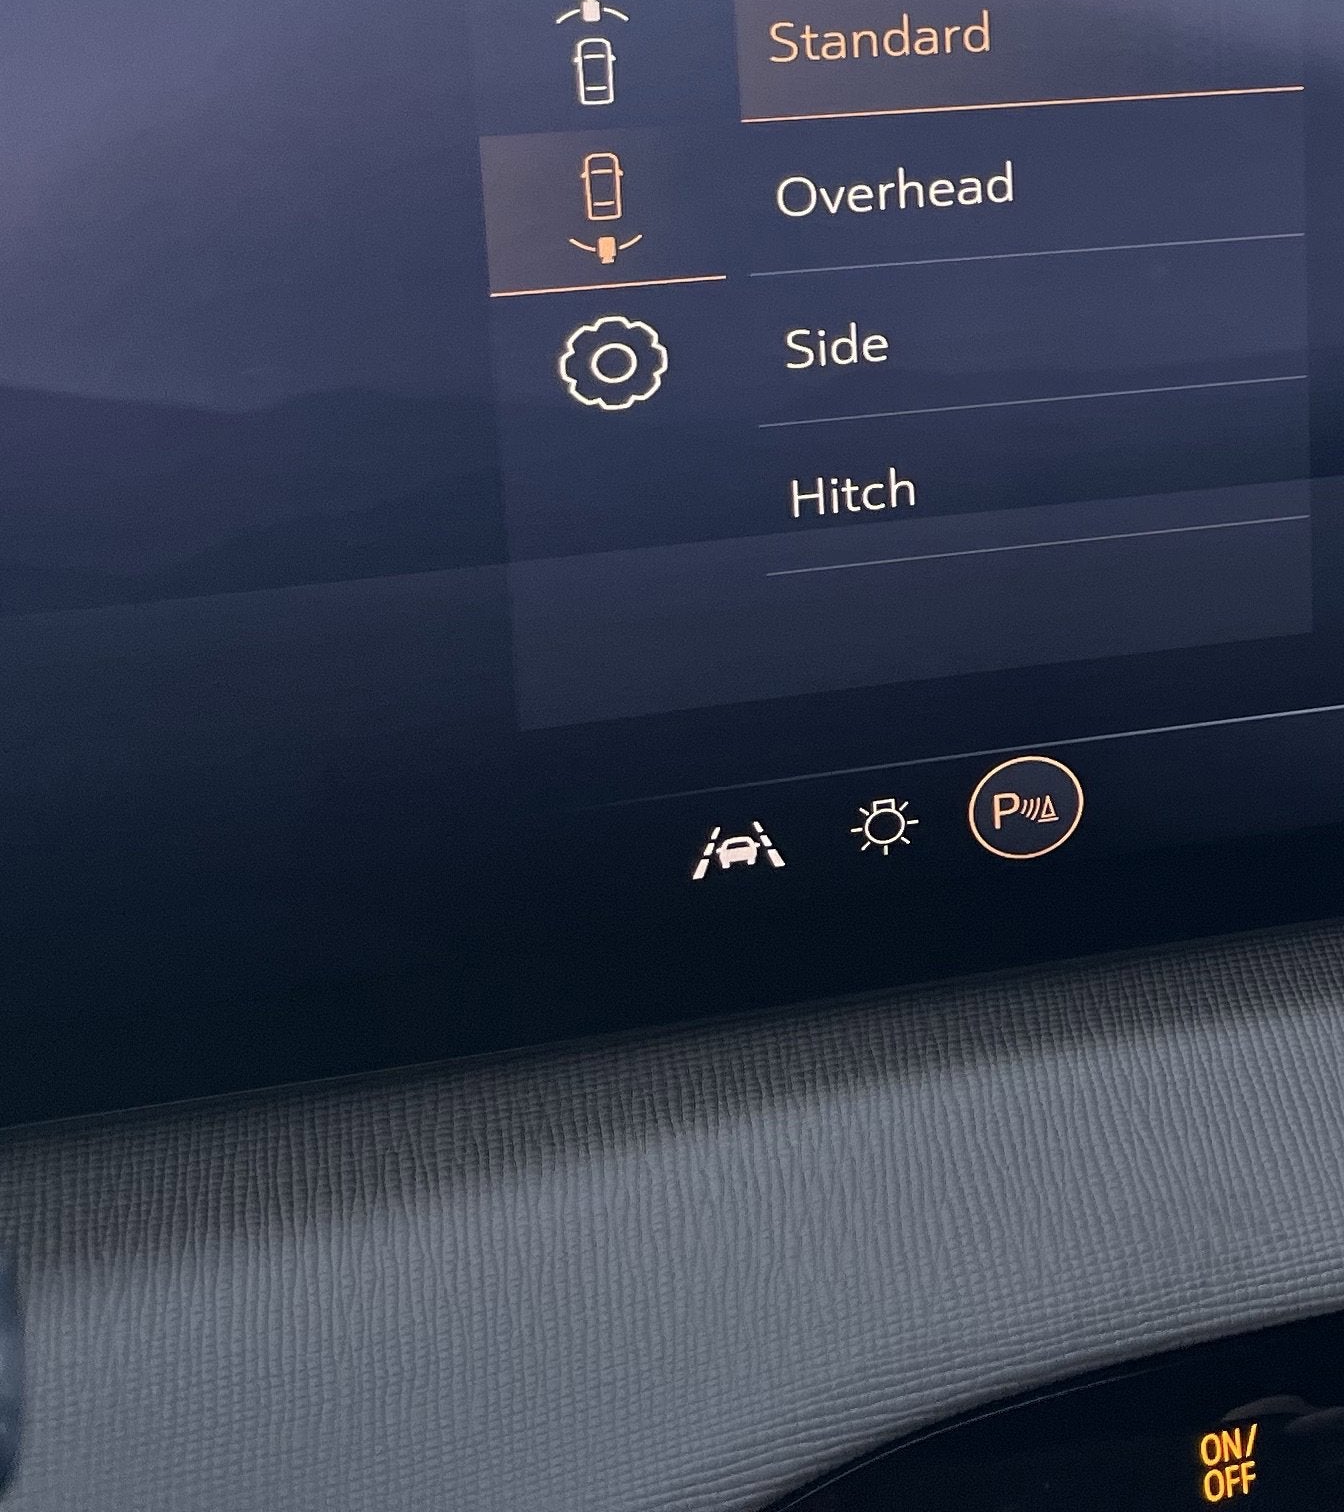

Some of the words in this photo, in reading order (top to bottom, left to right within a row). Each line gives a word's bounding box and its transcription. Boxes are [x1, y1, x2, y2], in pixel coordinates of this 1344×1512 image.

[768, 9, 991, 64] Standard
[775, 160, 1015, 218] Overhead
[785, 321, 890, 370] Side
[790, 467, 917, 519] Hitch
[1199, 1423, 1259, 1467] ON/
[1202, 1461, 1258, 1504] OFF
